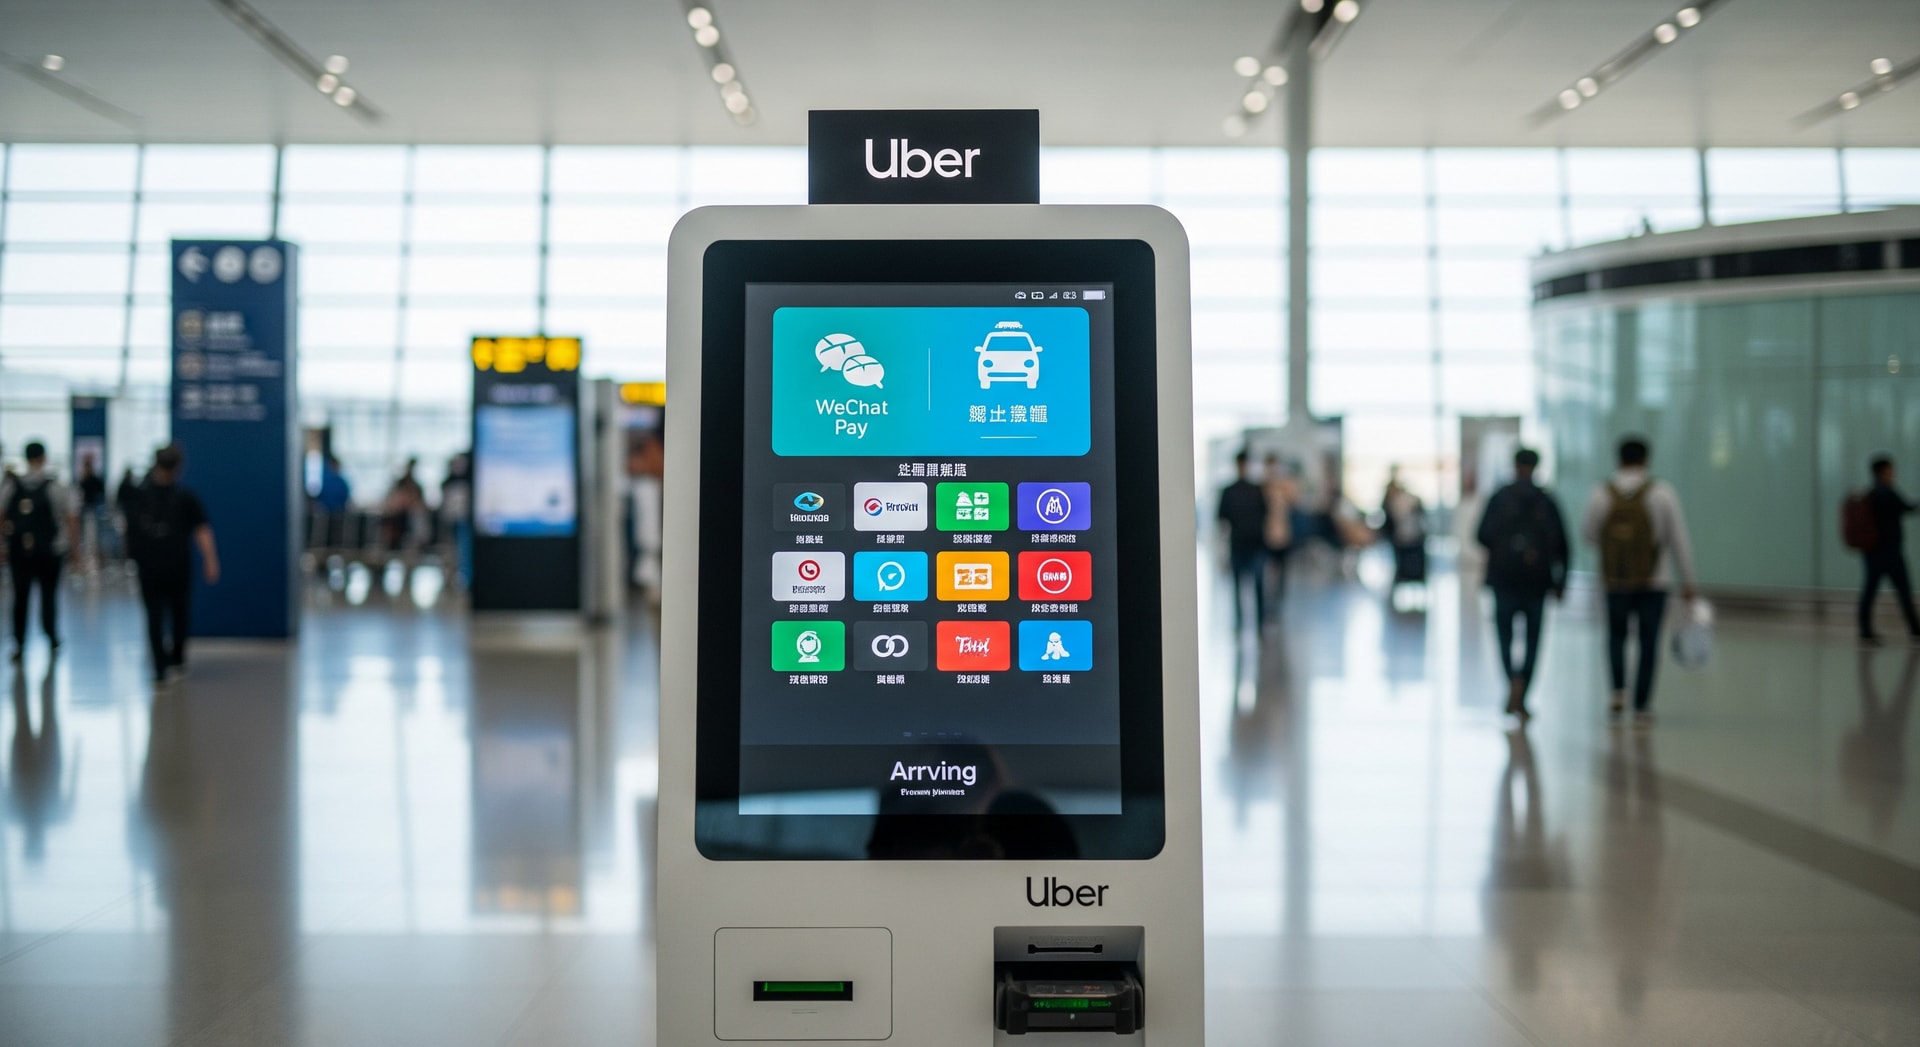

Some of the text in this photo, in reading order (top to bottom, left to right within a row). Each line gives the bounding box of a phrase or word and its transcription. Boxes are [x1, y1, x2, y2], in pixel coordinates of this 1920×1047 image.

[865, 138, 981, 179] Uber
[815, 399, 889, 416] WeChat
[835, 419, 868, 439] Pay
[890, 760, 977, 786] Arrving
[1025, 876, 1109, 907] Uber
